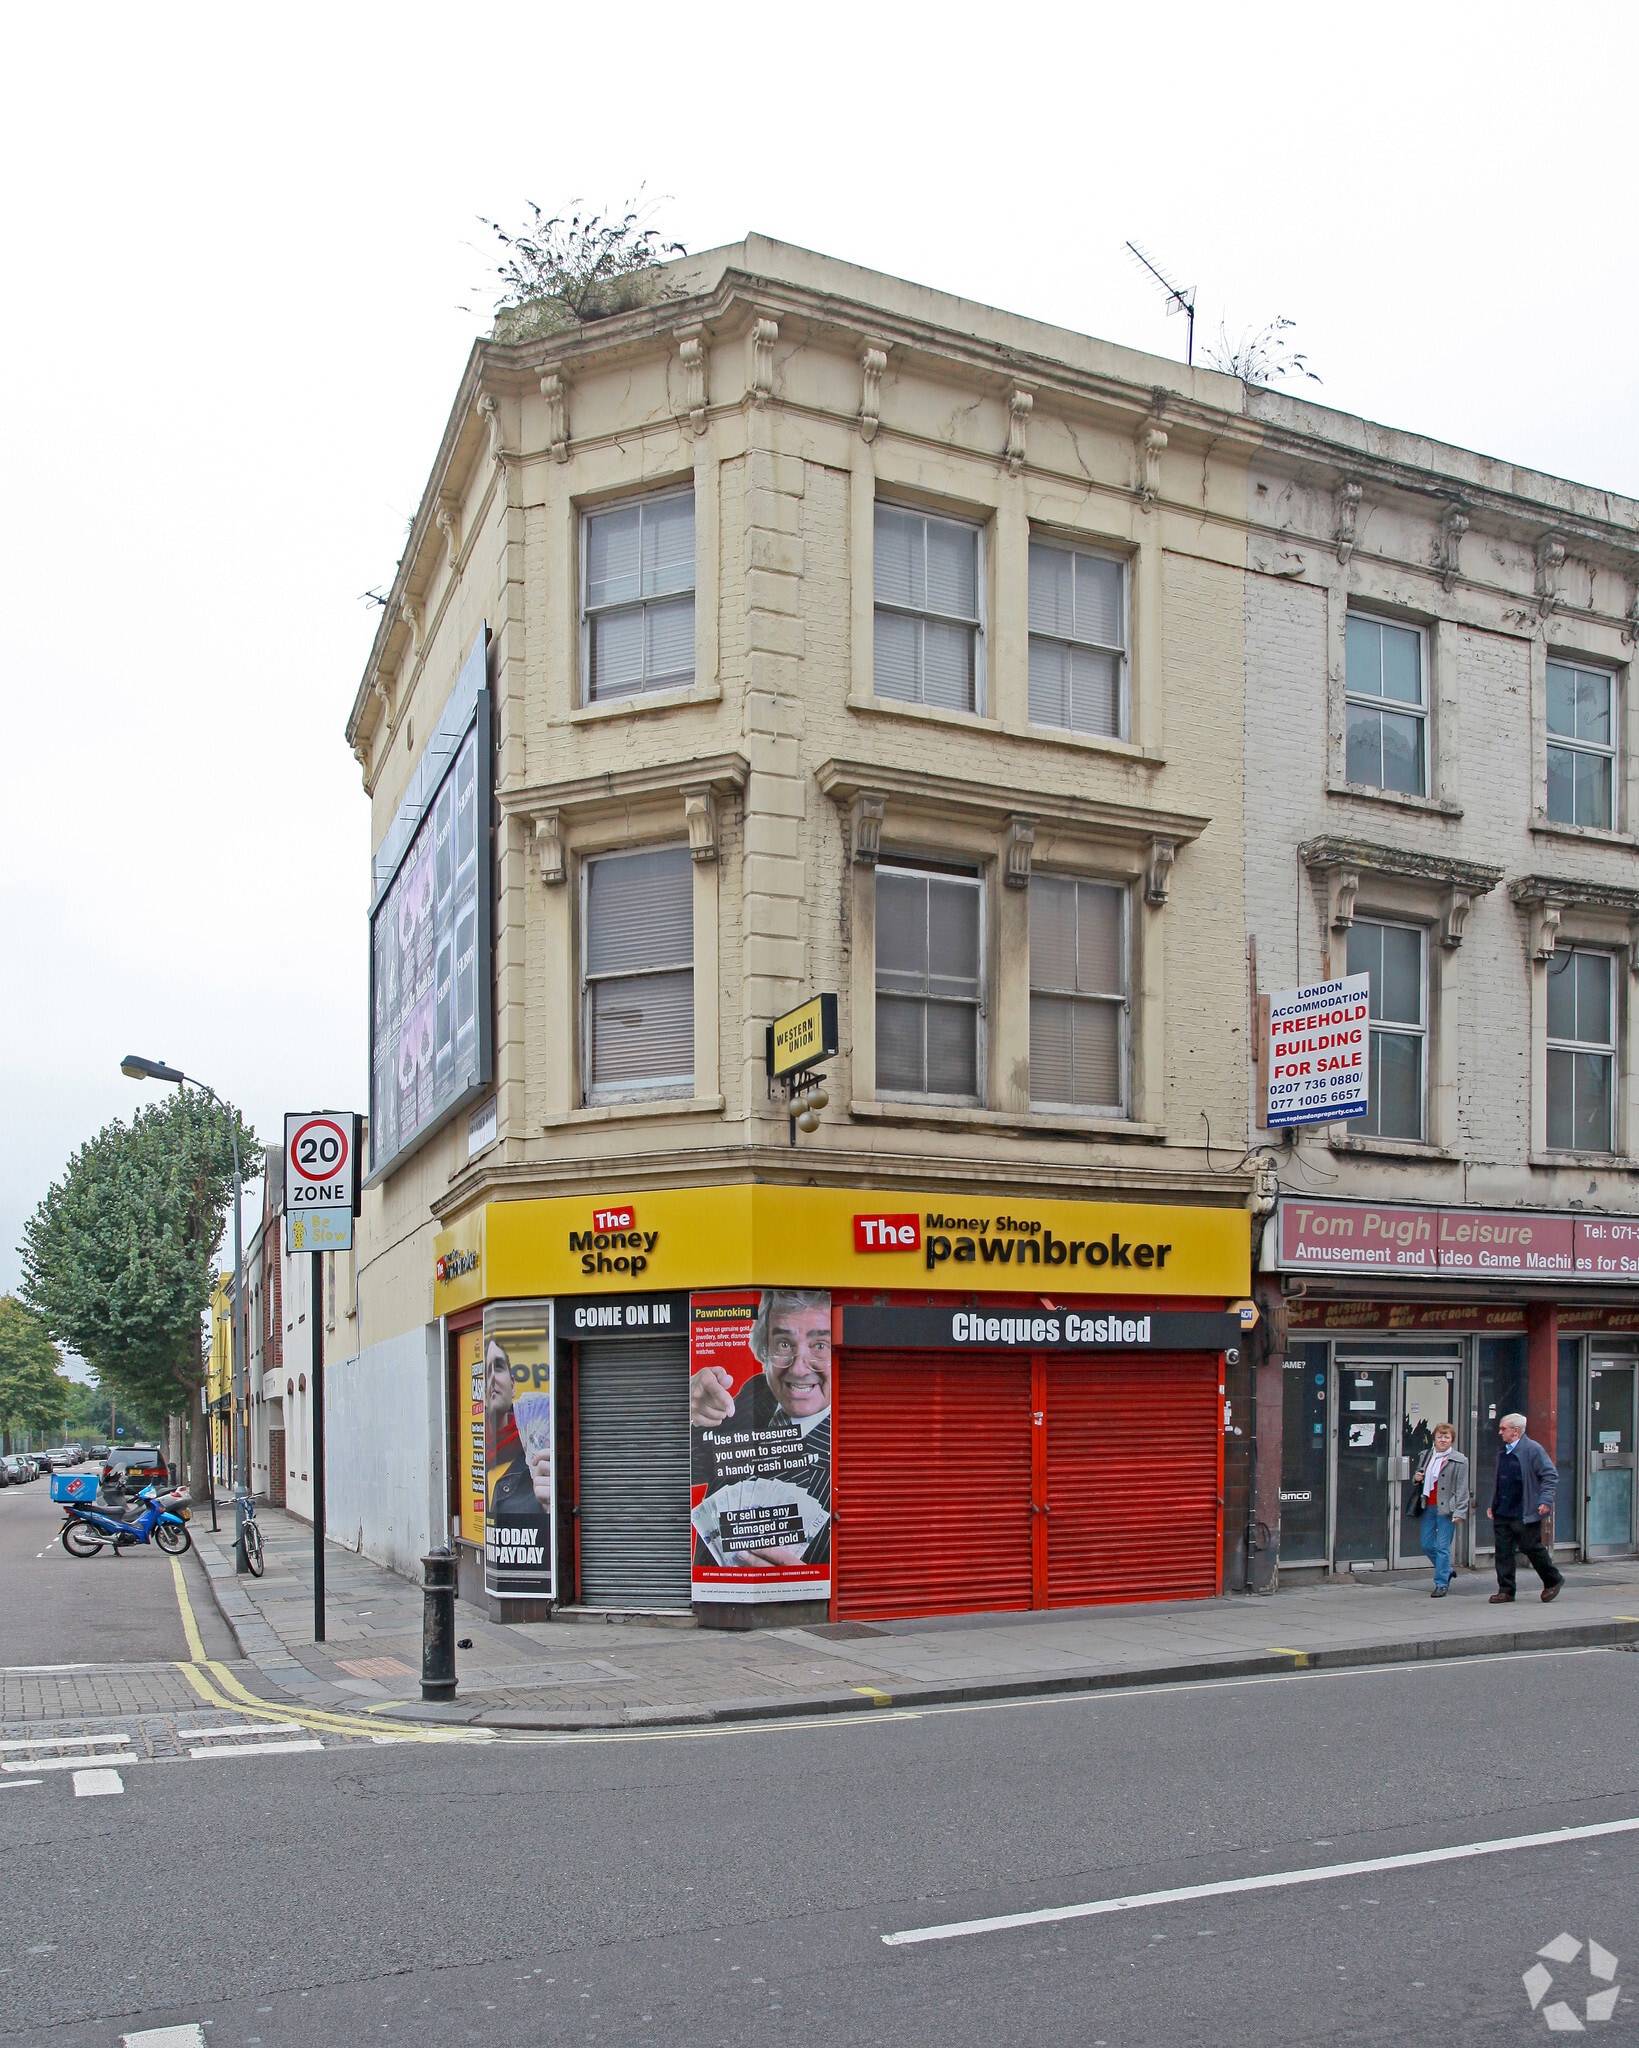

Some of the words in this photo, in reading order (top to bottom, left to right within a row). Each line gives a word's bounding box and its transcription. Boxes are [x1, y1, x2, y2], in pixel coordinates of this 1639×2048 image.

[1298, 982, 1342, 999] LONDON
[1272, 990, 1368, 1017] ACCOMMODATION
[1272, 1006, 1366, 1036] FREEHOLD
[776, 1017, 812, 1047] WESTERN
[788, 1030, 813, 1053] UNION
[1276, 1030, 1362, 1057] BUILDING
[1274, 1062, 1310, 1078] FOR
[1317, 1052, 1362, 1072] SALE
[1270, 1083, 1300, 1094] 0207
[1305, 1079, 1326, 1090] 736
[1330, 1072, 1363, 1086] 0880/
[1271, 1099, 1293, 1109] 077
[1298, 1094, 1326, 1106] 1005
[1331, 1088, 1360, 1102] 6657
[1270, 1106, 1364, 1124] www.toplondonproperty.co.uk
[300, 1138, 338, 1163] 20
[294, 1185, 344, 1201] ZONE
[312, 1216, 330, 1228] Be
[596, 1212, 630, 1228] The
[926, 1213, 990, 1234] Money
[996, 1216, 1042, 1236] Shop
[1296, 1210, 1354, 1236] Tom
[1363, 1214, 1430, 1246] Pugh
[1440, 1218, 1532, 1244] Leisure
[312, 1229, 347, 1242] Slow
[570, 1231, 658, 1252] Money
[860, 1219, 916, 1245] The
[1584, 1224, 1606, 1238] Tel:
[926, 1230, 1172, 1270] pawnbroker
[1295, 1242, 1390, 1262] Amusement
[1396, 1249, 1424, 1264] and
[1478, 1250, 1520, 1267] Game
[1598, 1256, 1616, 1270] for
[582, 1252, 646, 1276] Shop
[575, 1306, 622, 1328] COME
[626, 1305, 648, 1325] ON
[653, 1304, 670, 1324] IN
[696, 1308, 752, 1318] Pawnbroking
[952, 1312, 1060, 1344] Cheques
[1064, 1314, 1150, 1343] Cashed
[734, 1432, 749, 1442] the
[752, 1428, 798, 1441] treasures
[716, 1452, 732, 1463] you
[736, 1448, 756, 1458] own
[758, 1446, 768, 1456] to
[771, 1443, 804, 1454] secure
[717, 1468, 723, 1476] a
[726, 1464, 755, 1476] handy
[758, 1460, 781, 1472] cash
[1278, 1489, 1310, 1501] amco
[726, 1512, 737, 1522] Or
[740, 1509, 756, 1520] sell
[759, 1509, 770, 1518] us
[773, 1507, 790, 1518] any
[496, 1528, 538, 1546] TODAY
[732, 1521, 776, 1536] damaged
[778, 1520, 788, 1530] or
[730, 1536, 776, 1550] unwanted
[778, 1533, 799, 1546] gold
[496, 1546, 544, 1564] PAYDAY
